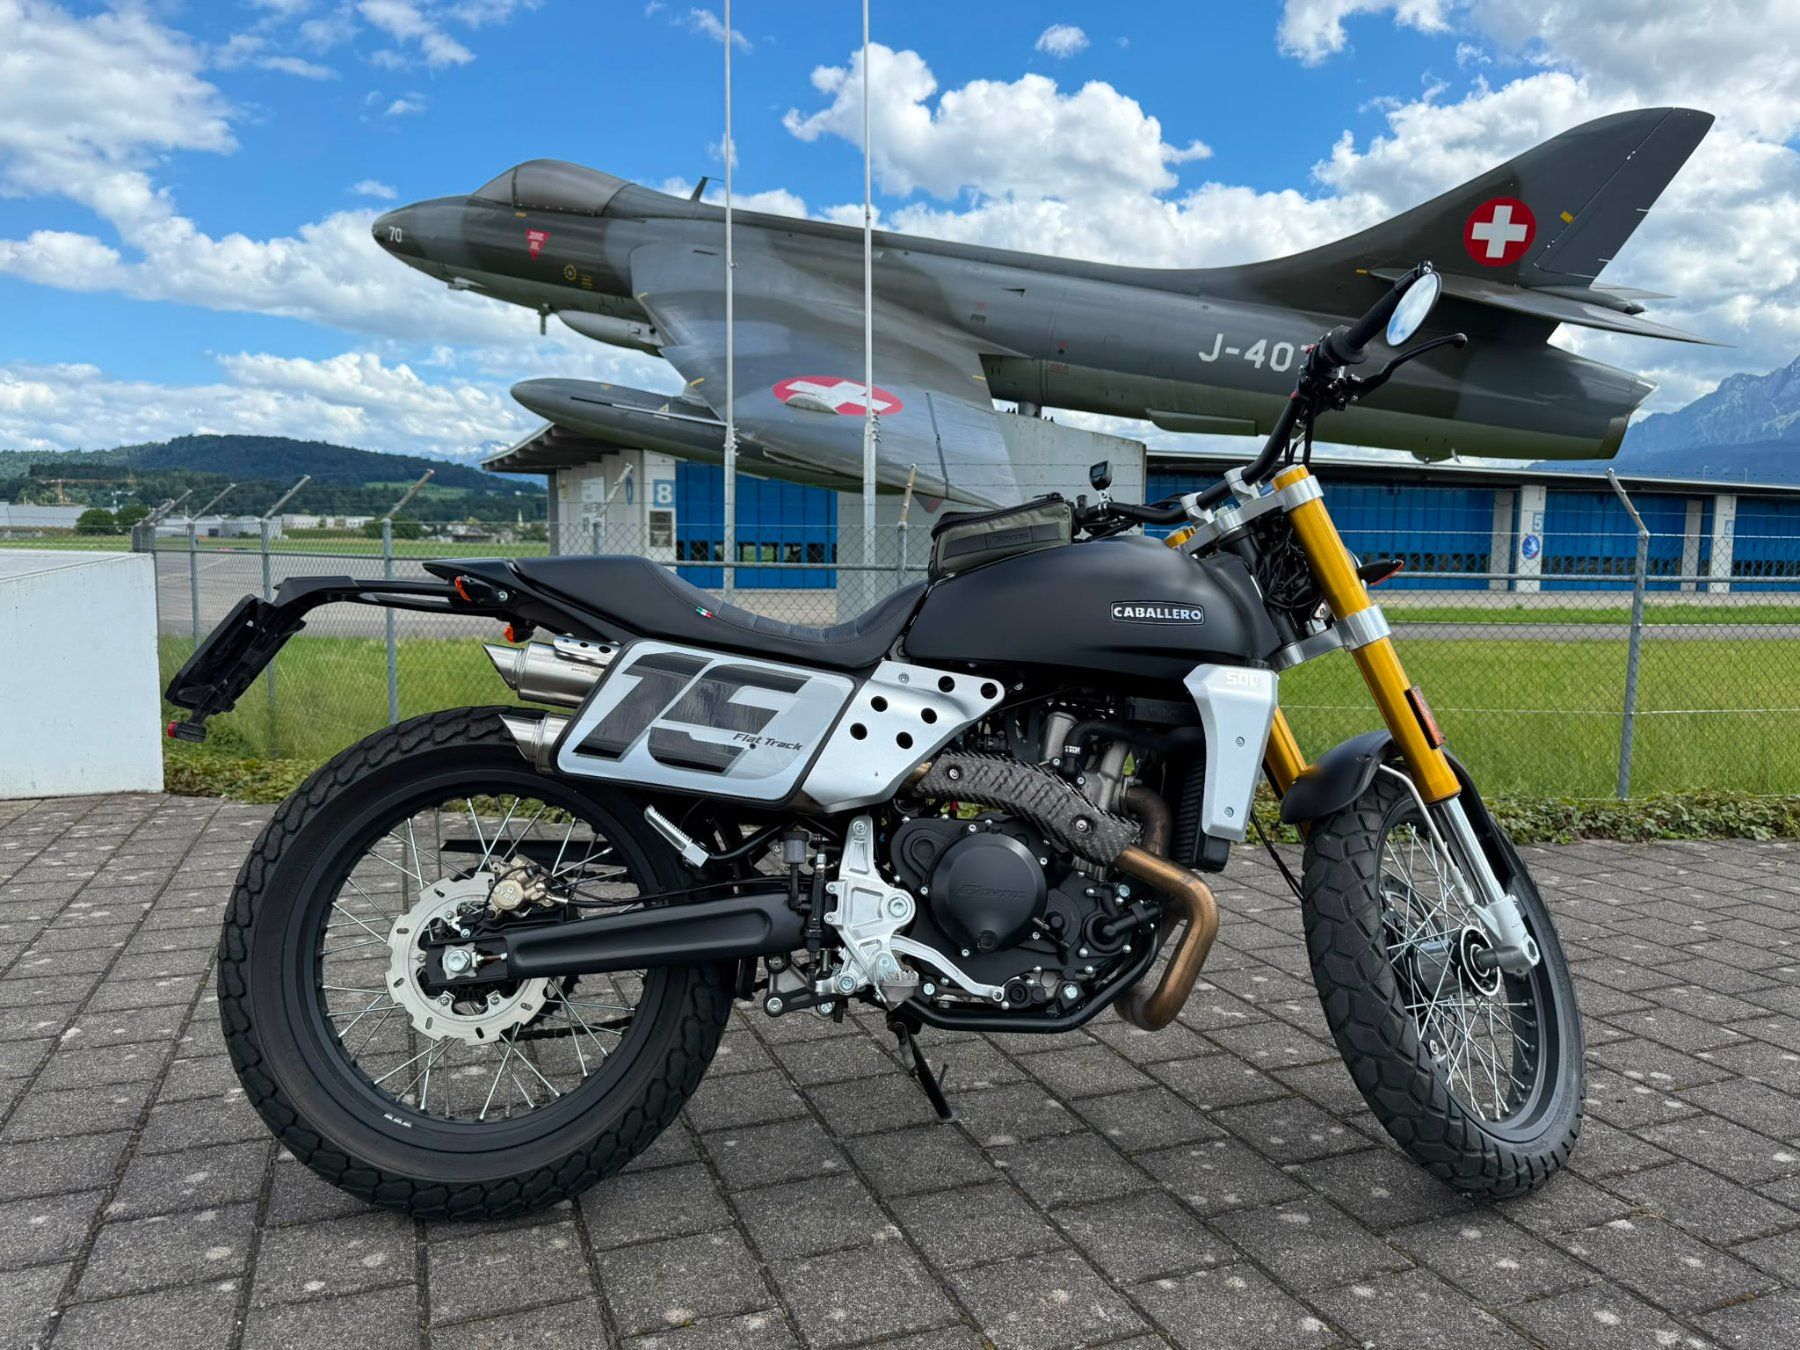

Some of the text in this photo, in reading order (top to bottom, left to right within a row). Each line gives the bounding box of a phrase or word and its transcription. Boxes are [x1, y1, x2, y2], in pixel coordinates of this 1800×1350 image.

[388, 226, 402, 243] 70
[1198, 333, 1309, 373] J-40
[656, 483, 673, 504] 8
[1533, 514, 1543, 531] 5
[1113, 607, 1202, 621] CABALLERO
[732, 732, 803, 751] Flat Track
